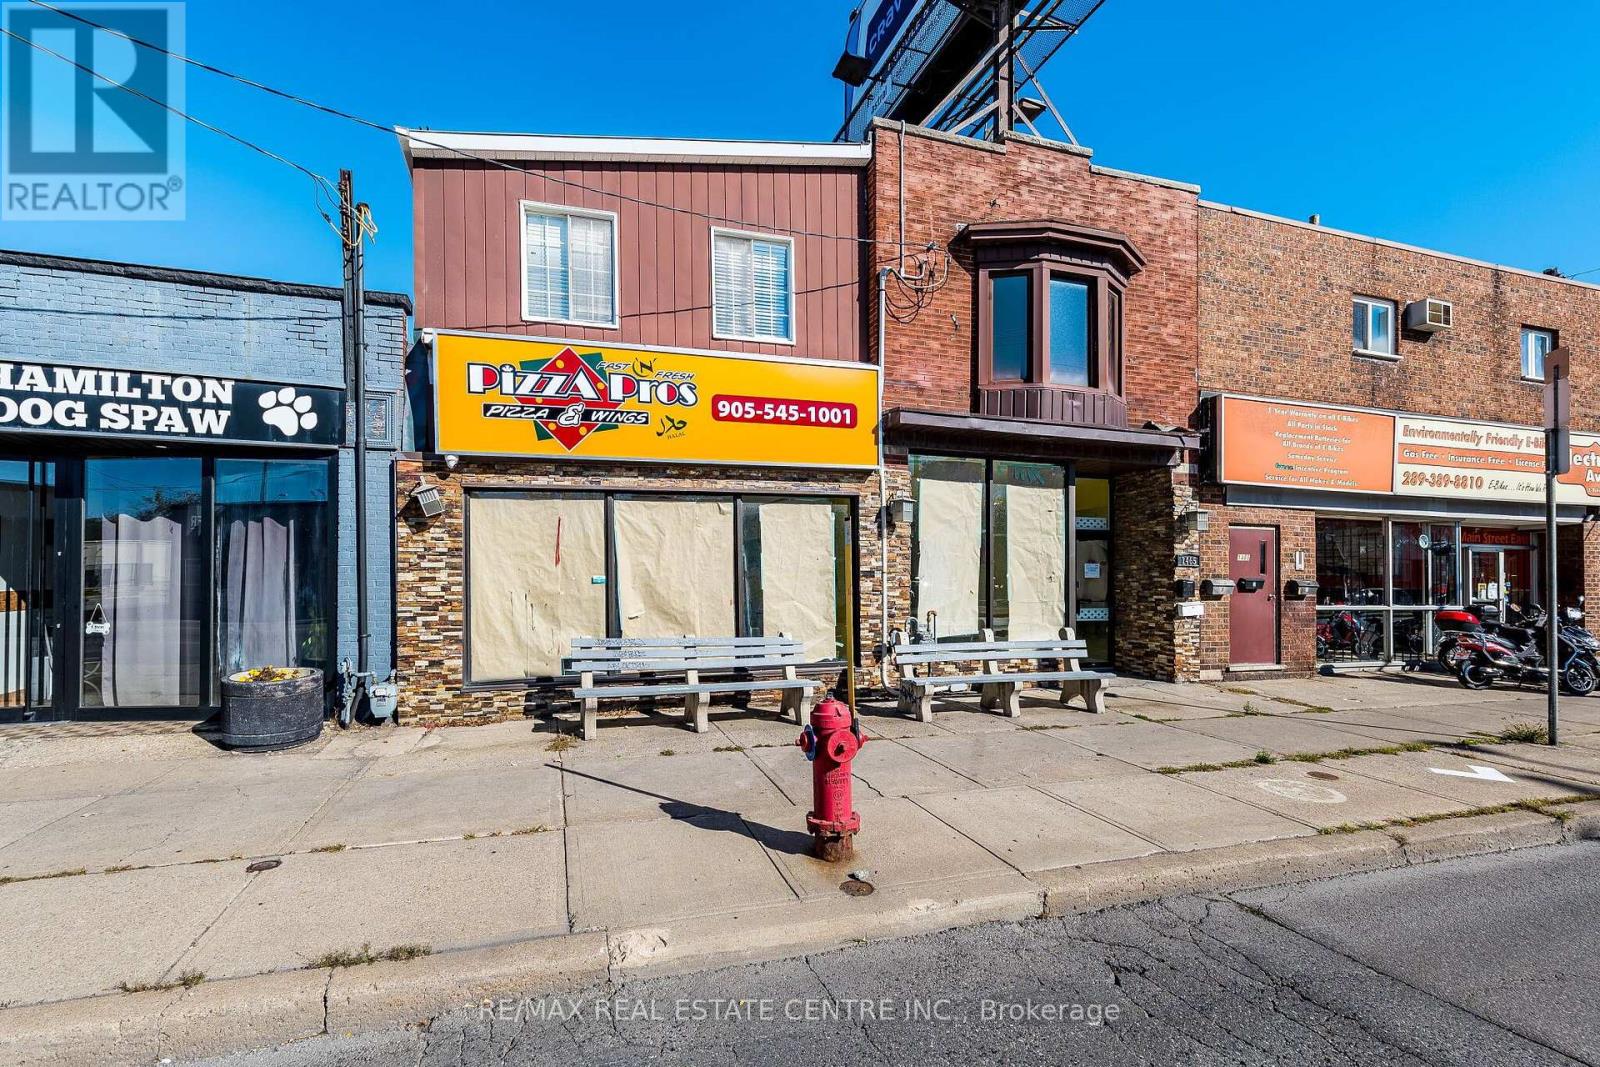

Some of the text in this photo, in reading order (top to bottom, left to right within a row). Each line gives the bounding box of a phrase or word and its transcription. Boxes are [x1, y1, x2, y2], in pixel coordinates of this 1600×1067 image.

[595, 361, 631, 370] FAST
[655, 371, 695, 380] FRESH
[607, 372, 699, 407] Pros
[100, 403, 231, 435] SPAW
[486, 403, 648, 427] PIZZA & WINGS
[717, 400, 851, 425] 905-545-1001
[1403, 425, 1546, 449] Environmentally Friendly E-Bi
[1403, 449, 1420, 458] Gas
[1421, 450, 1440, 459] Free
[1448, 454, 1485, 464] Insurance
[1515, 458, 1540, 468] License
[1570, 447, 1600, 468] lect
[1402, 471, 1484, 489] 289-389-8810
[1482, 532, 1508, 544] Street
